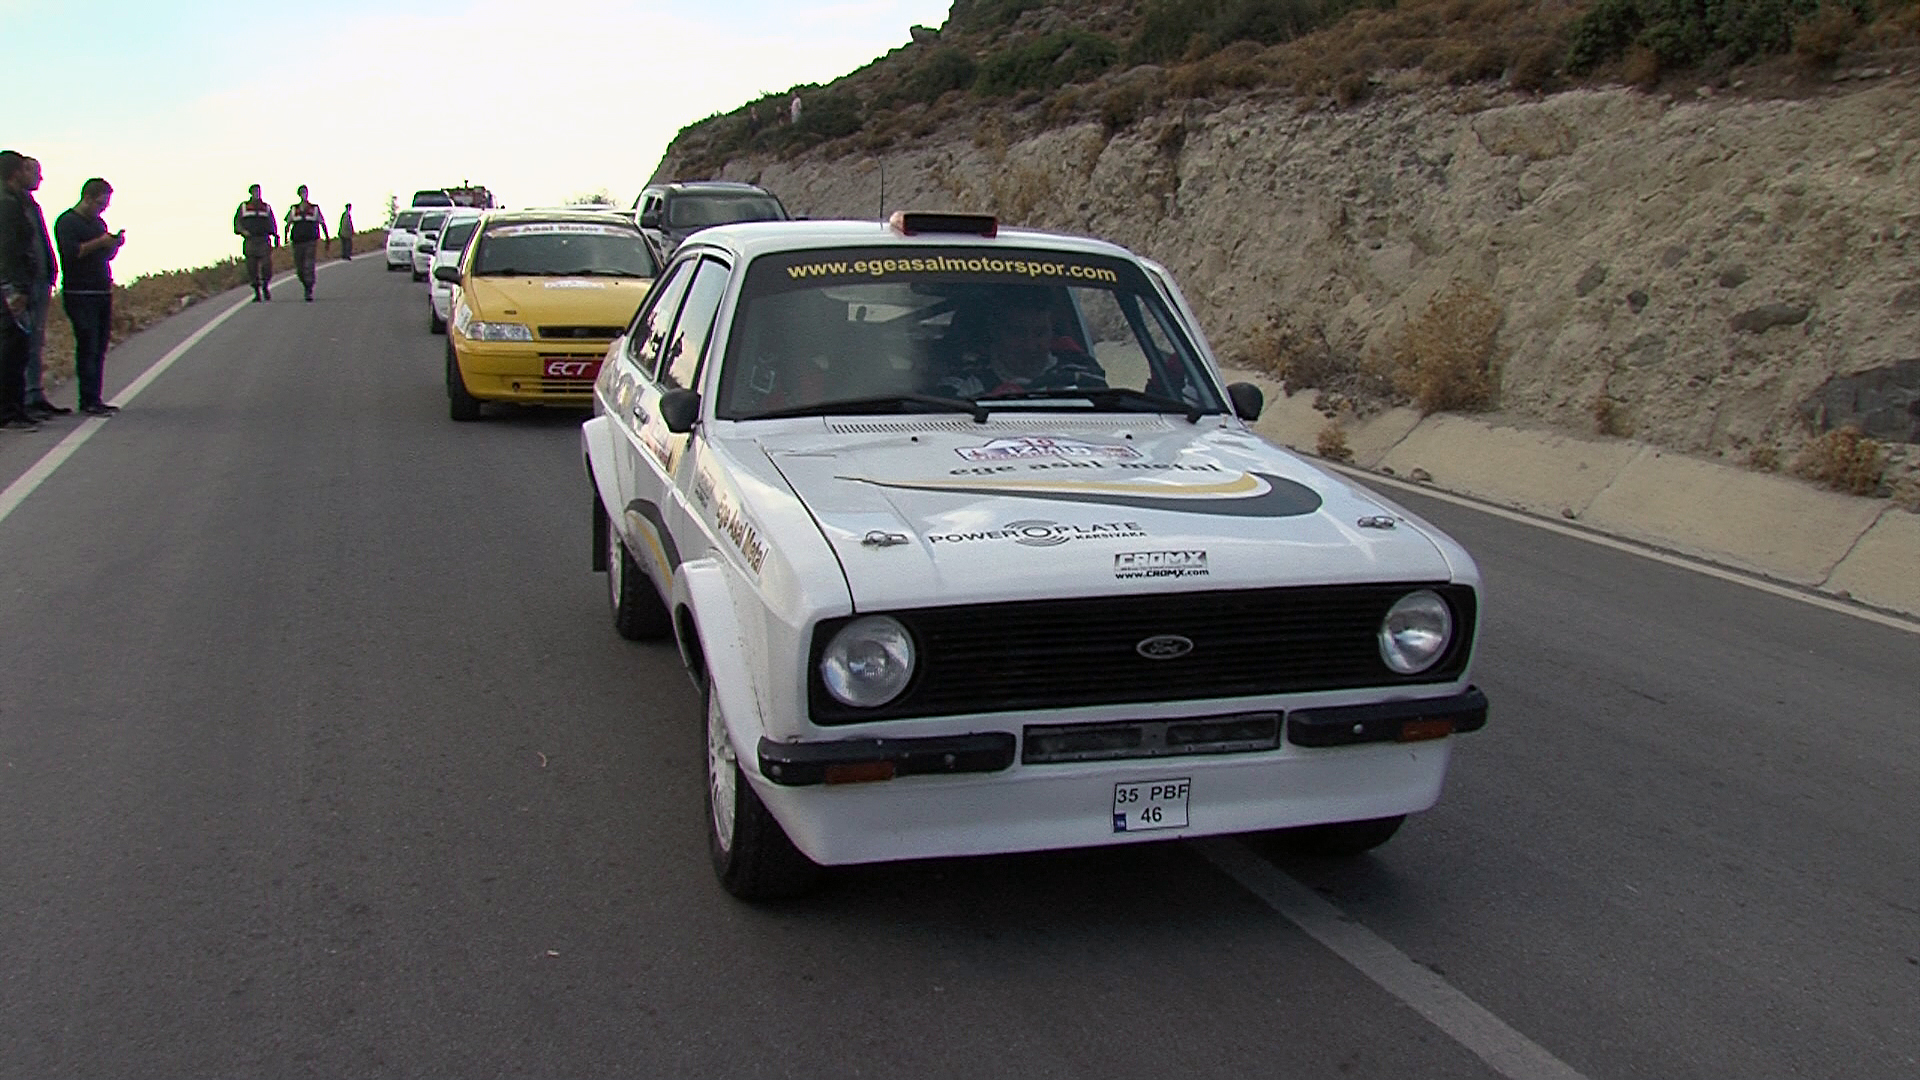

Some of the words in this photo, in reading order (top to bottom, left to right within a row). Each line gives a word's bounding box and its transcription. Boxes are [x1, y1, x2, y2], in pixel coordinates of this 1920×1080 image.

[787, 256, 1118, 283] www.egeasalmotorspor.com
[548, 361, 593, 376] ECT
[1118, 462, 1222, 473] metal
[928, 529, 1019, 544] POWER
[1053, 521, 1143, 537] PLATE
[1118, 551, 1206, 568] CROMX
[1115, 569, 1209, 579] www.CROMX.com
[1117, 788, 1139, 804] 35
[1150, 784, 1190, 801] PBF
[1140, 806, 1162, 823] 46
